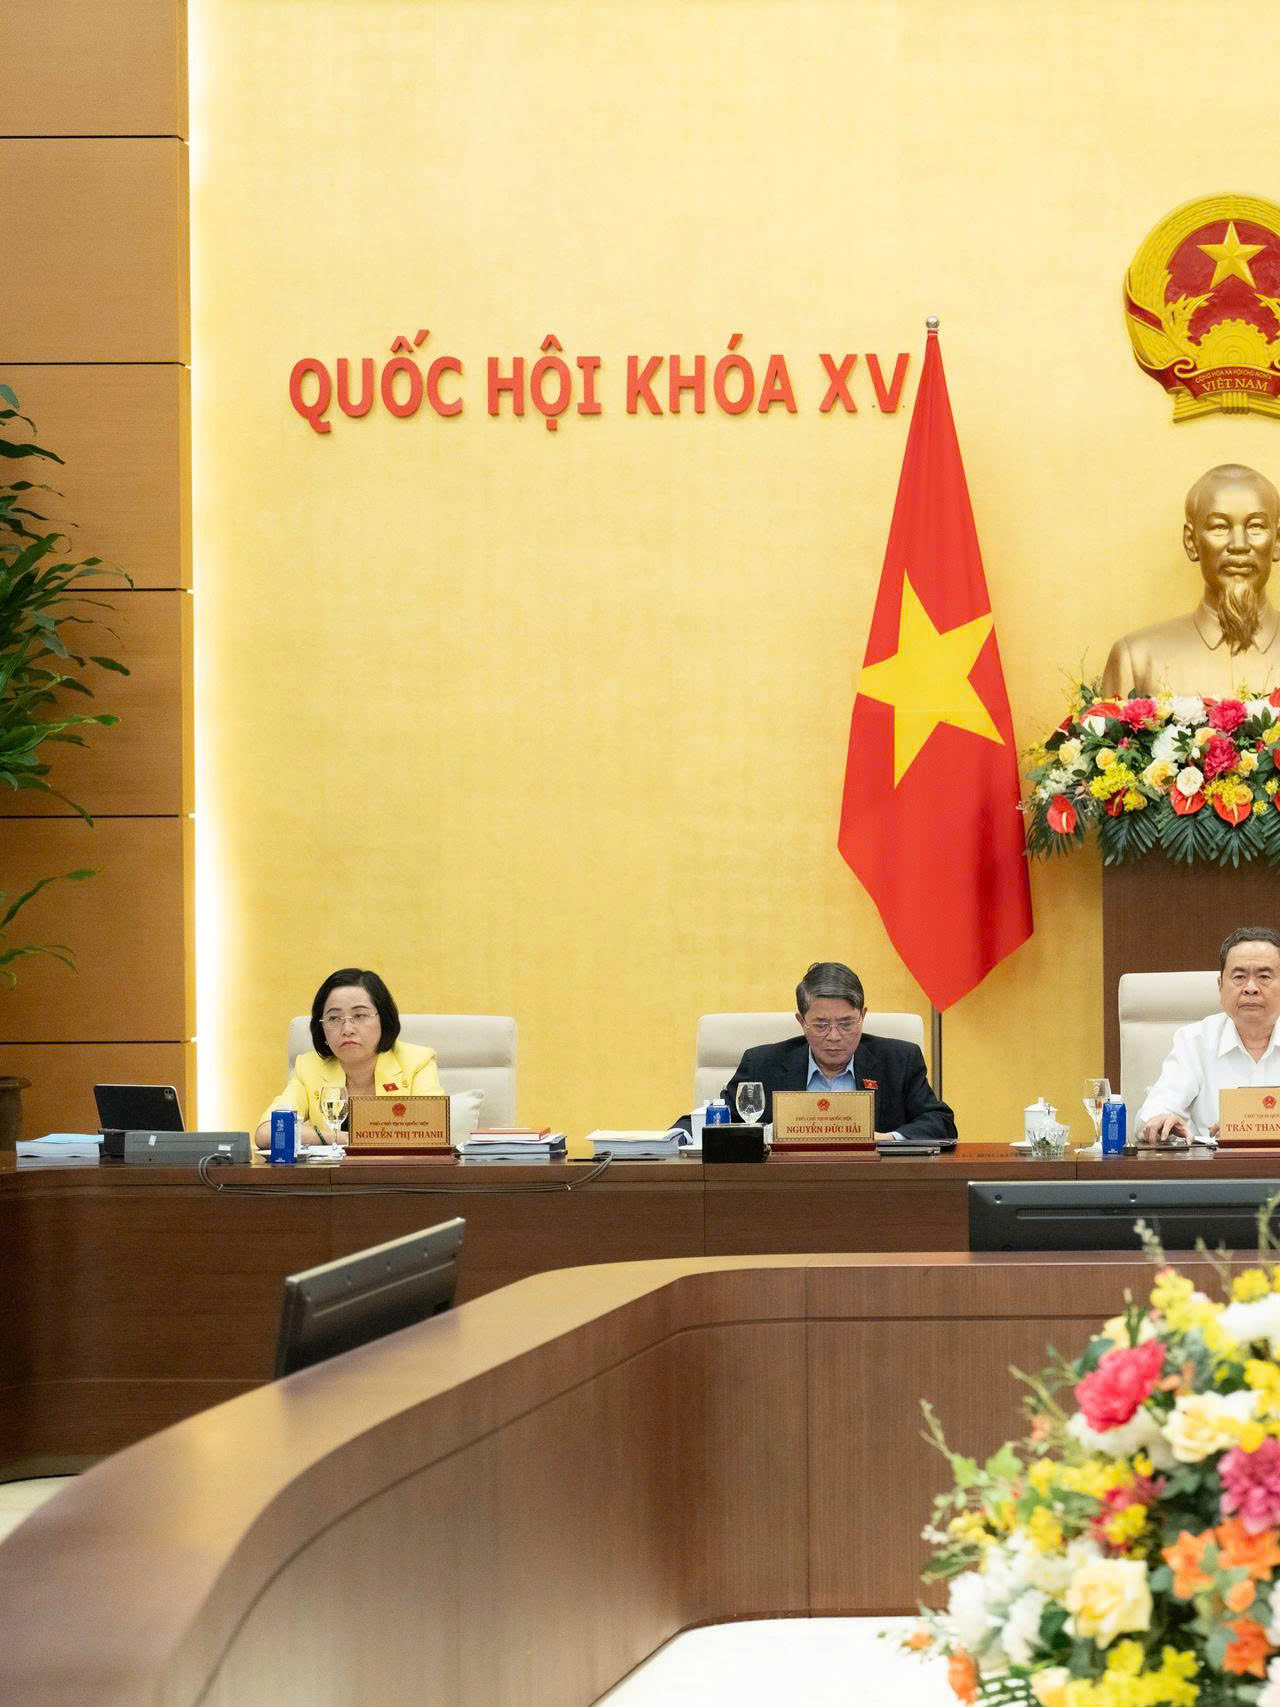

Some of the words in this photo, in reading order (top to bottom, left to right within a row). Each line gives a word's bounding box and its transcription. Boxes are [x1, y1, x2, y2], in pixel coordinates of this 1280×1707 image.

[289, 329, 462, 433] QUỐC
[487, 334, 602, 431] HỘI
[626, 333, 797, 416] KHÓA
[819, 353, 910, 414] XV
[1234, 378, 1268, 391] NAM
[355, 1127, 393, 1138] NGUYỄN
[394, 1131, 410, 1141] THỊ
